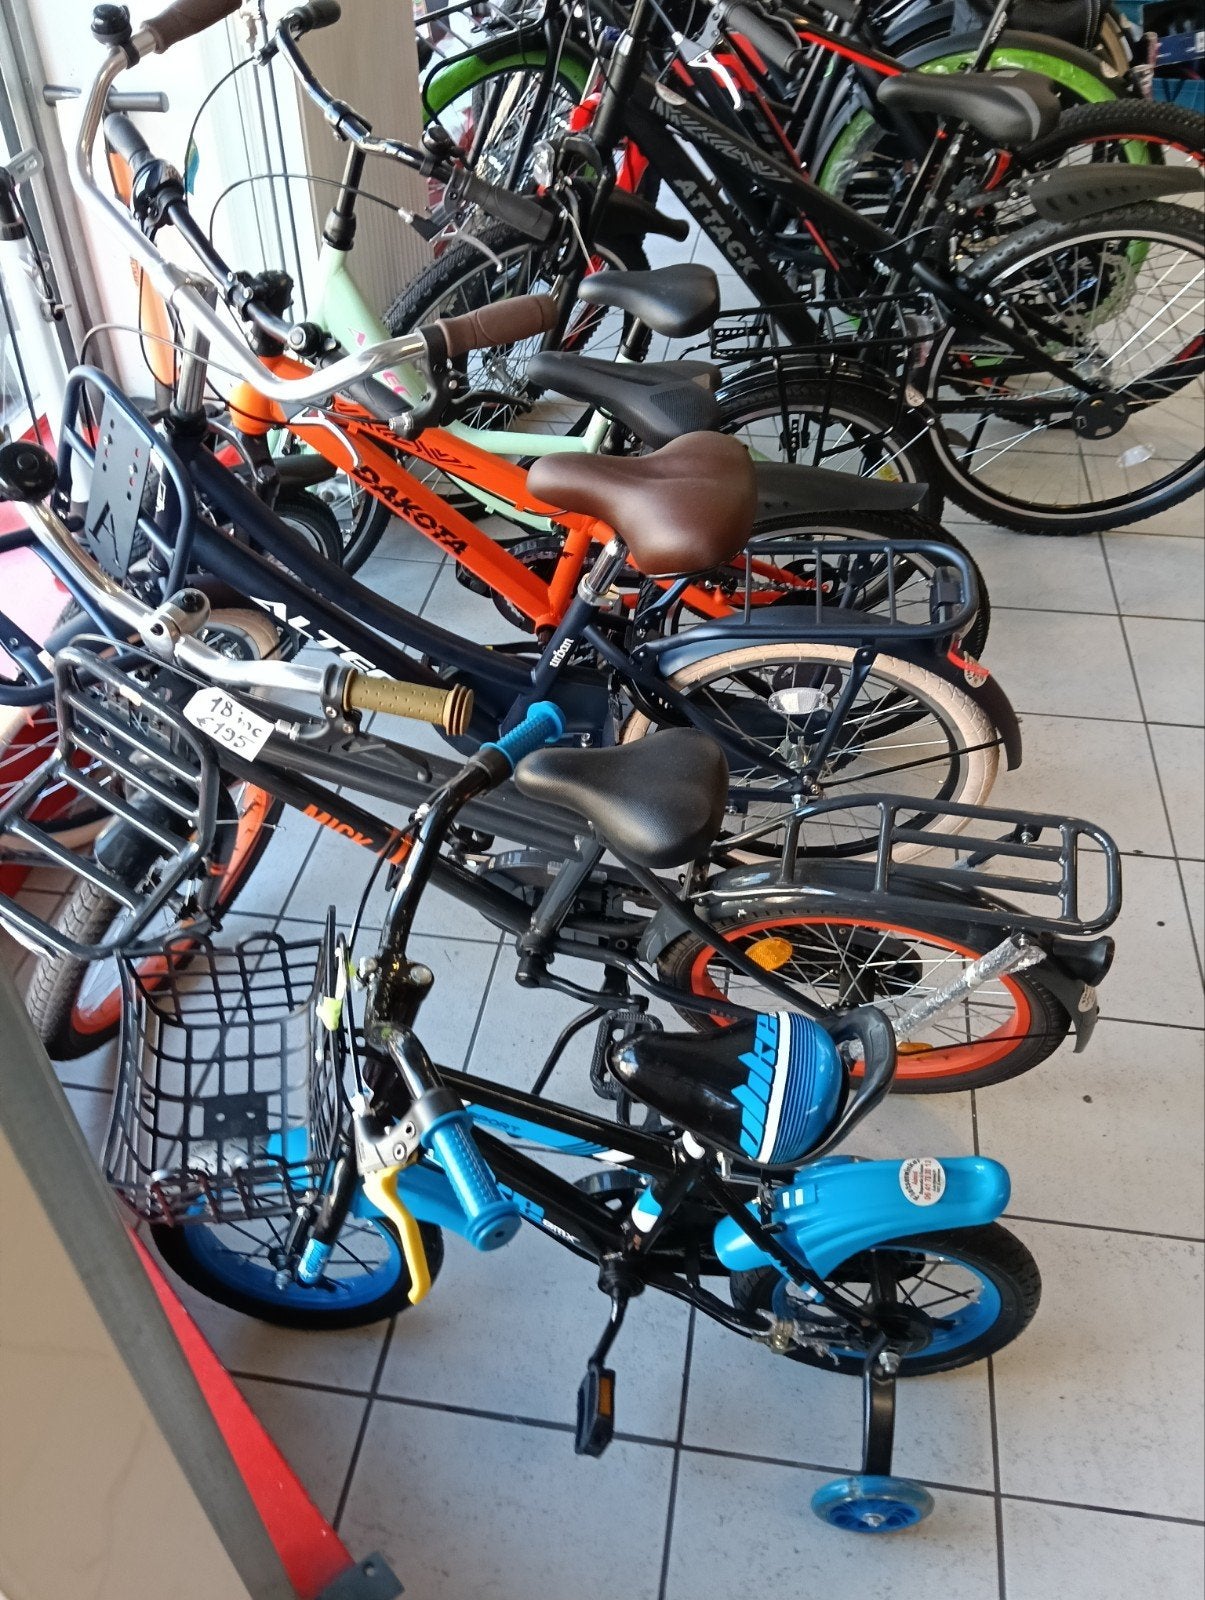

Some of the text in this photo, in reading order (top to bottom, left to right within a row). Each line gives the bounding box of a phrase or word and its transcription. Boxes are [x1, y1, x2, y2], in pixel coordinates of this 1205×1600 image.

[673, 178, 761, 276] ATTACK
[351, 465, 468, 555] DAKOTA
[549, 637, 575, 668] urban
[210, 697, 234, 718] 18
